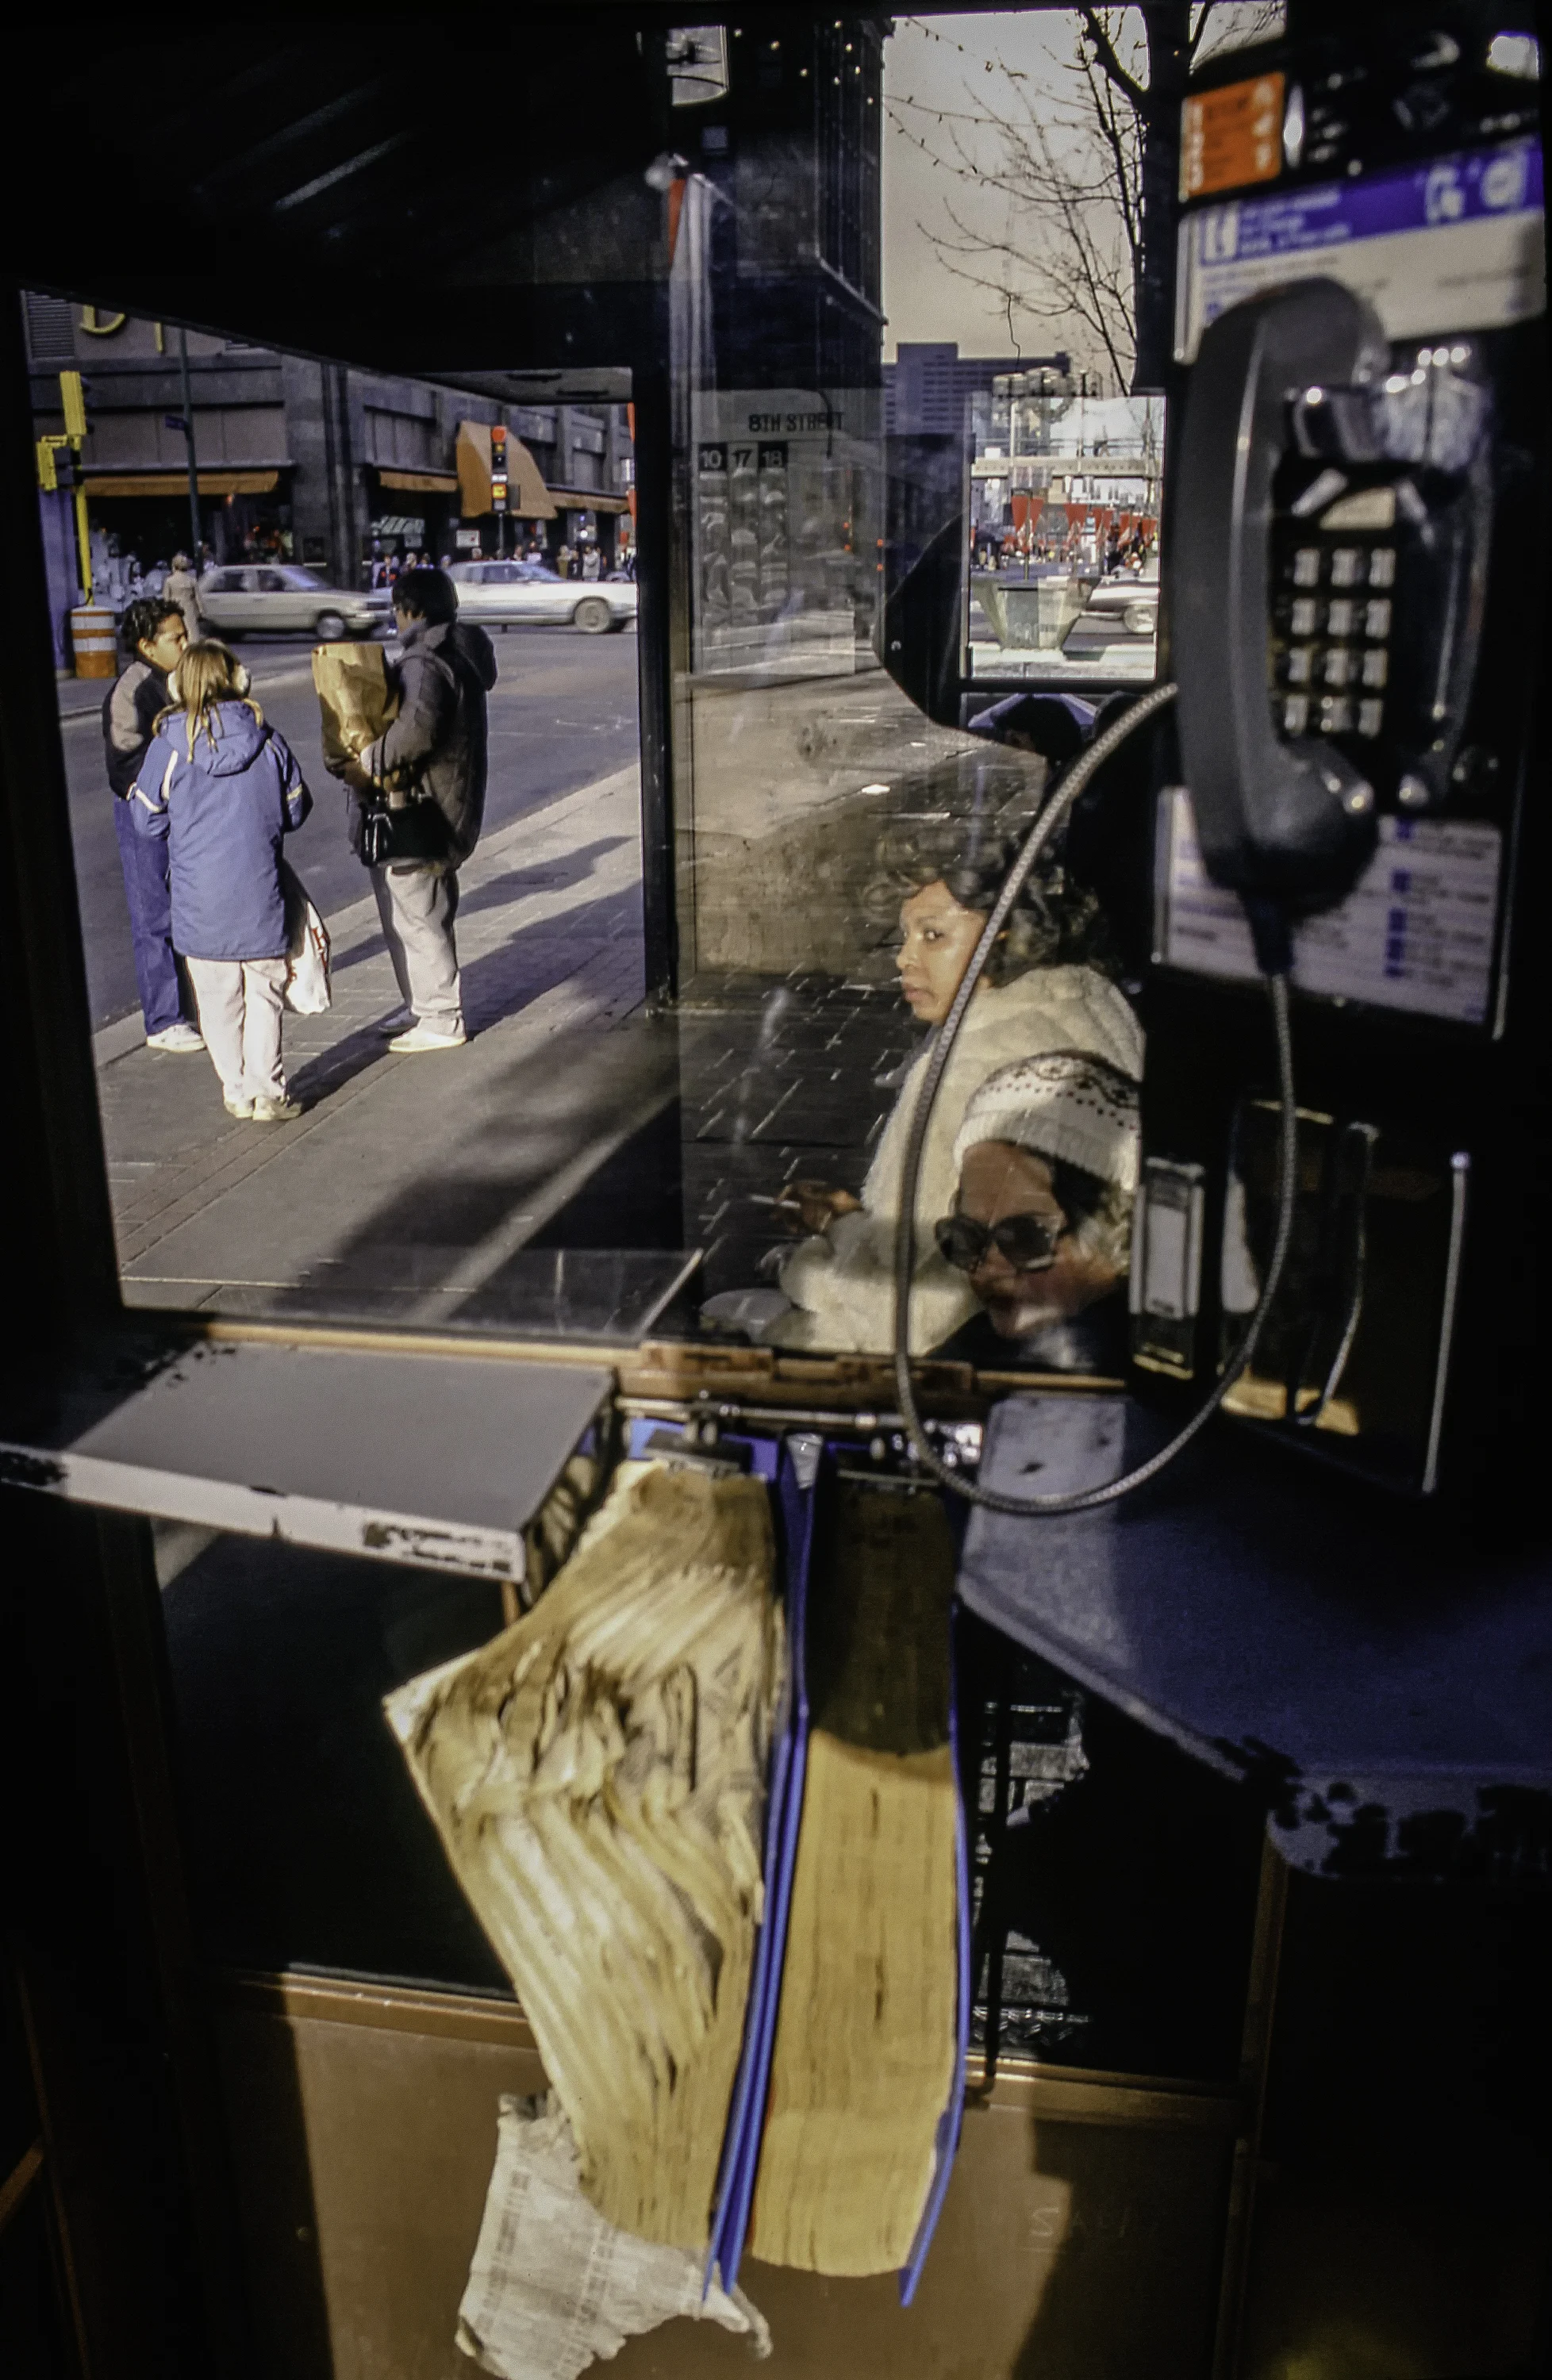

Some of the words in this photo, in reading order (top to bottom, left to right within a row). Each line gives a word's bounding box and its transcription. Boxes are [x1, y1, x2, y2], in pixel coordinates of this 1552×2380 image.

[748, 413, 781, 432] 8TH
[700, 450, 722, 469] 10
[732, 449, 753, 468] 17
[762, 450, 783, 468] 18
